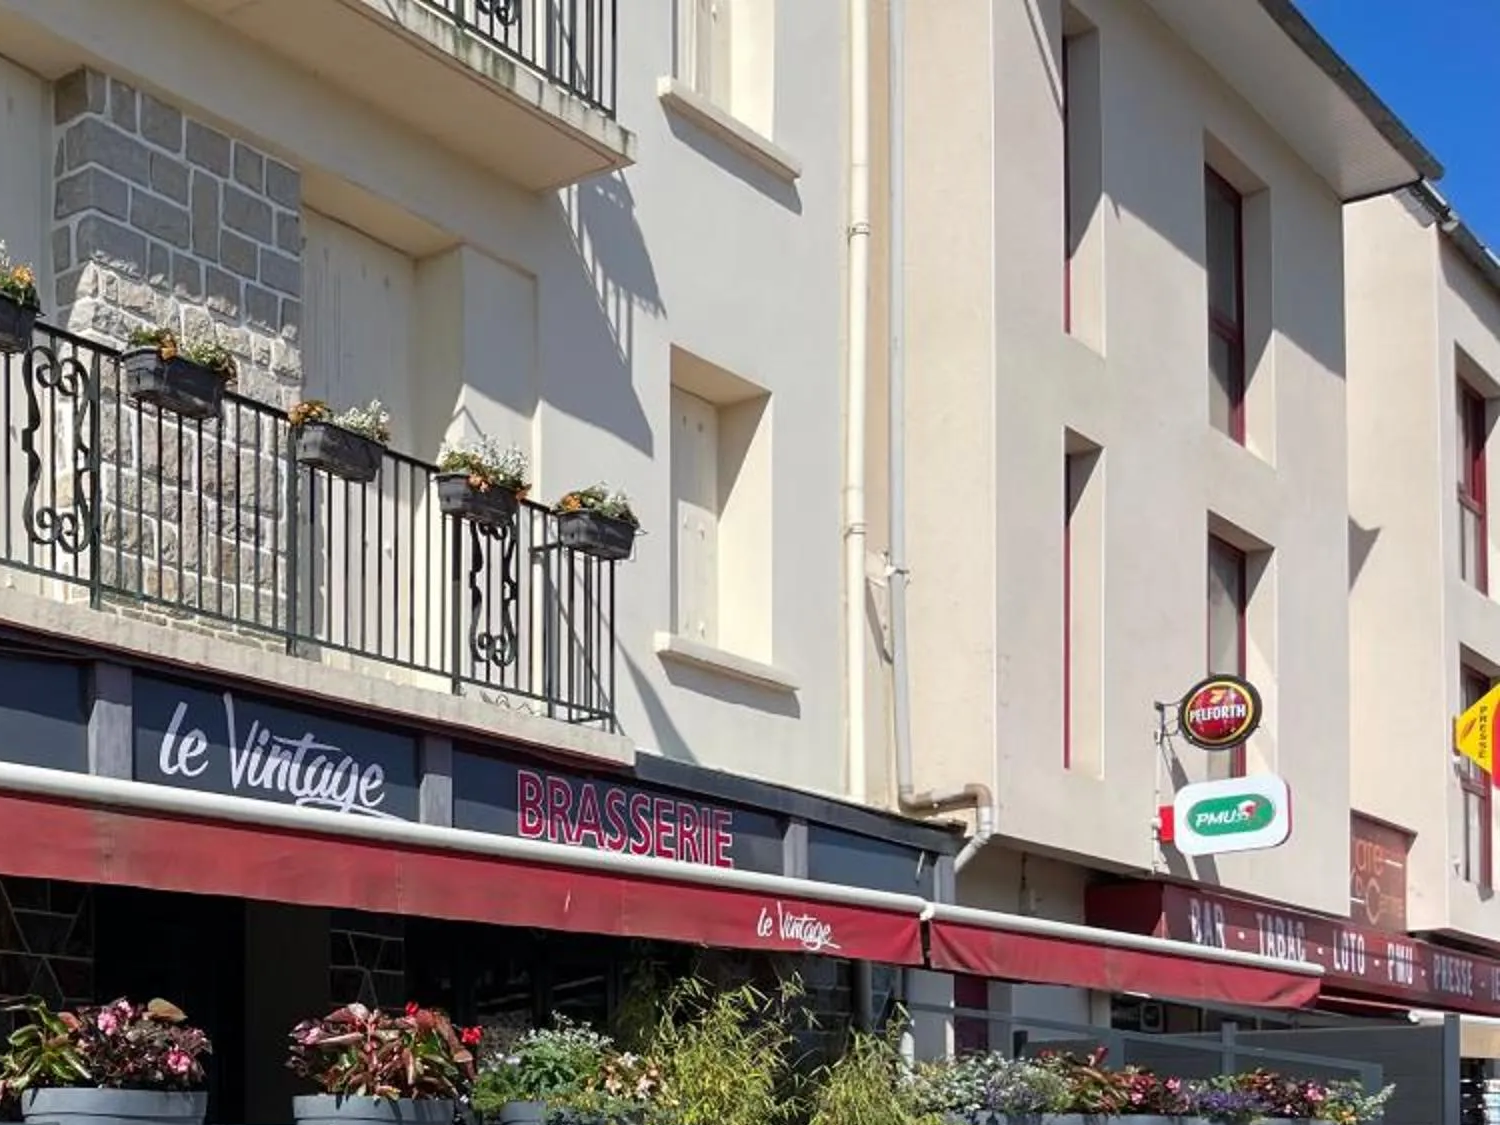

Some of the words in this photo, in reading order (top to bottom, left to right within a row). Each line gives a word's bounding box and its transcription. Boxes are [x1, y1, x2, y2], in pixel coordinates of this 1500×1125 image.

[1189, 703, 1247, 724] PELFORTH
[223, 691, 405, 820] Vintage
[517, 769, 733, 869] BRASSERIE
[1195, 810, 1237, 828] PMU
[777, 900, 841, 951] Vintage
[1189, 898, 1226, 952] BAR
[1256, 911, 1306, 962] TABAC
[1333, 929, 1366, 976] LOTO
[1387, 942, 1414, 985] PMU
[1432, 953, 1474, 998] PRESSE
